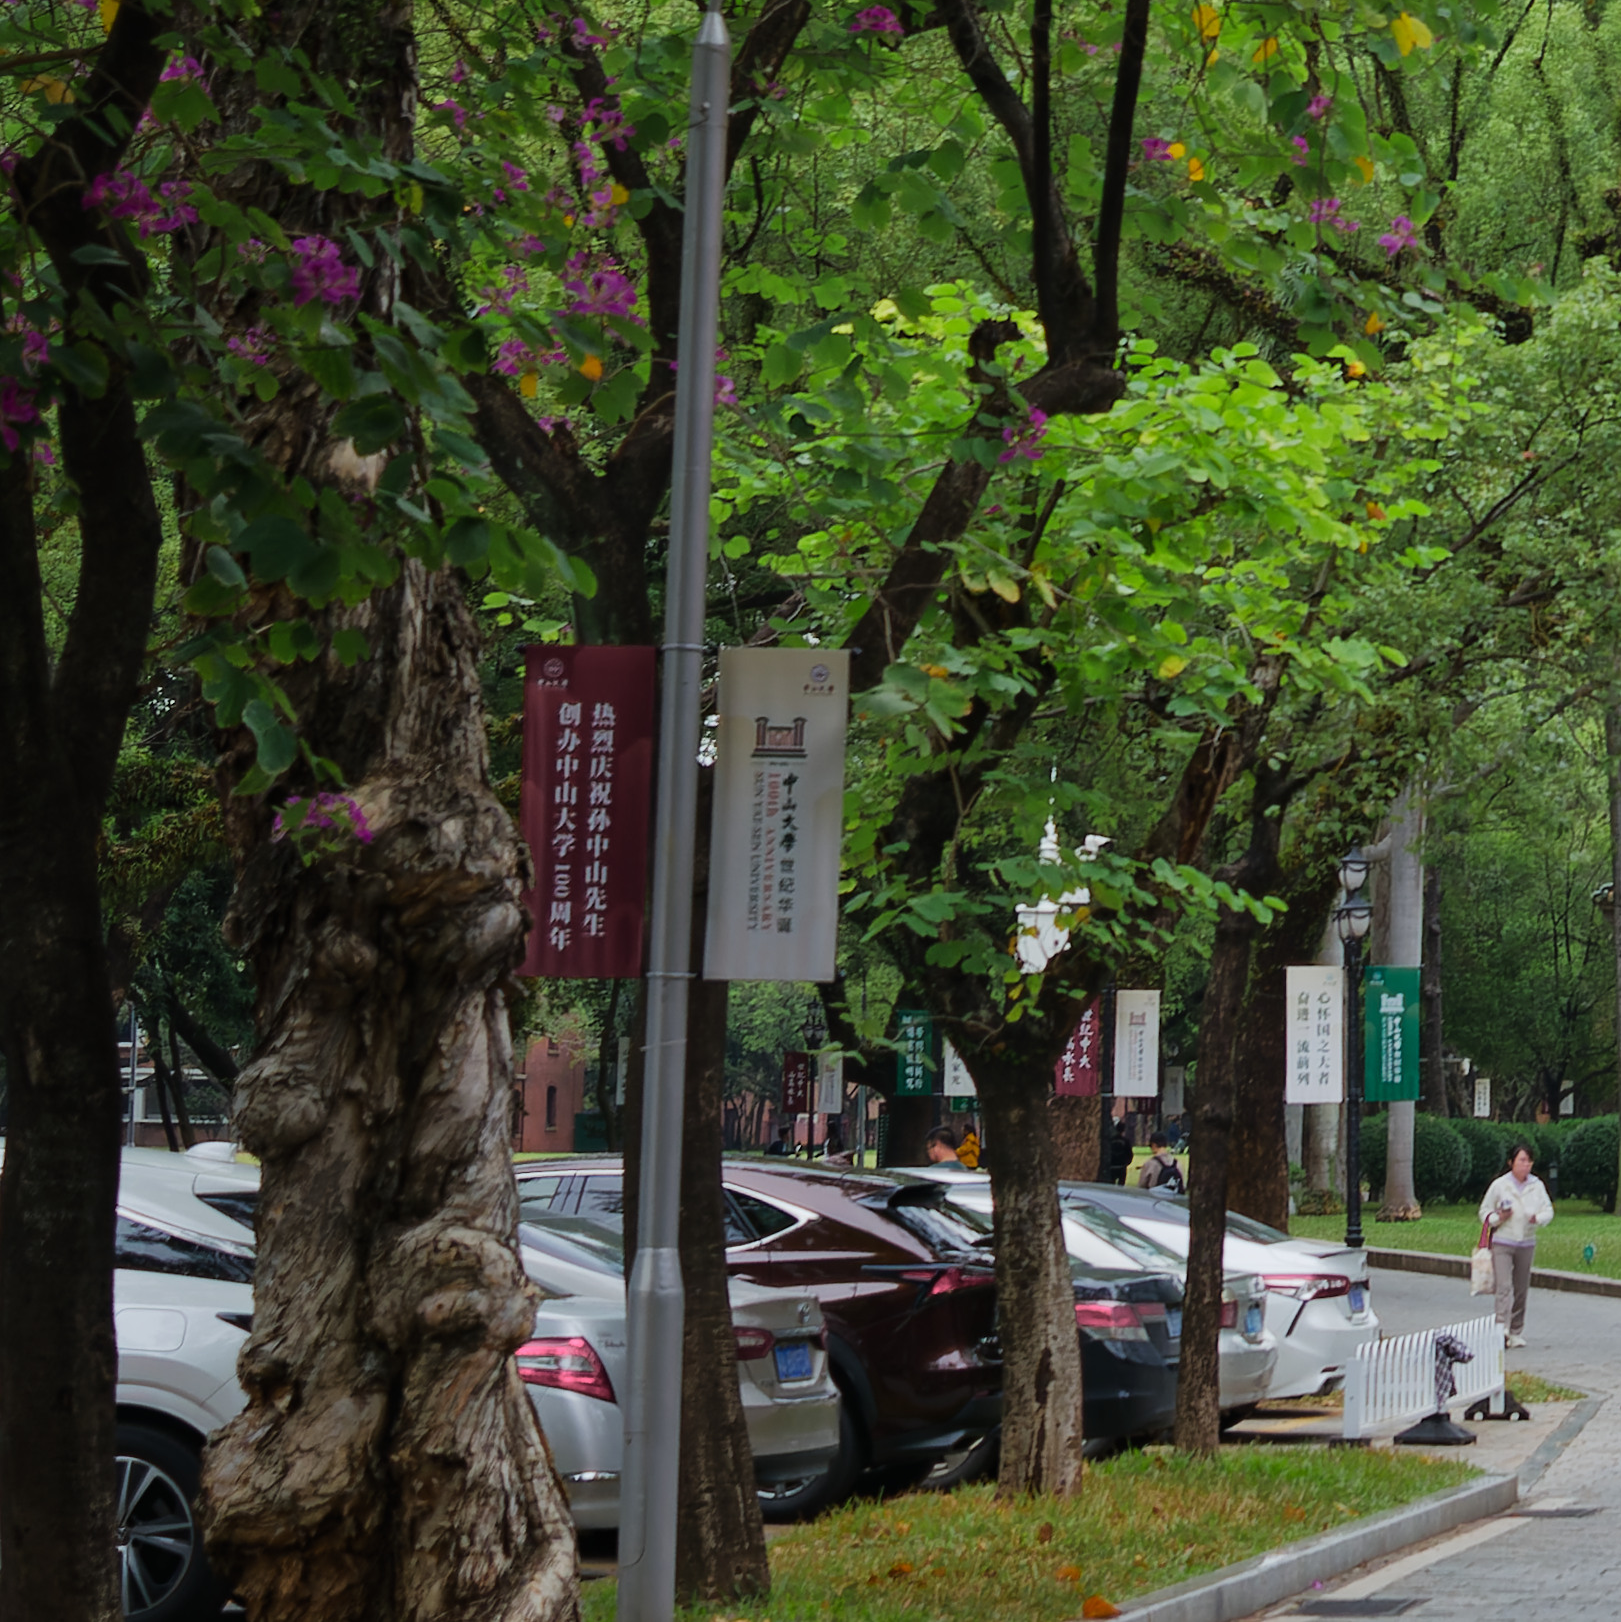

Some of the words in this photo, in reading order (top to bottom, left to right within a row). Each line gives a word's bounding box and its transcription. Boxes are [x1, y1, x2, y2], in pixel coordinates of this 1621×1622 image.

[550, 702, 582, 952] 创办中山大学100周年
[582, 702, 616, 937] 热烈庆祝孙中山先生
